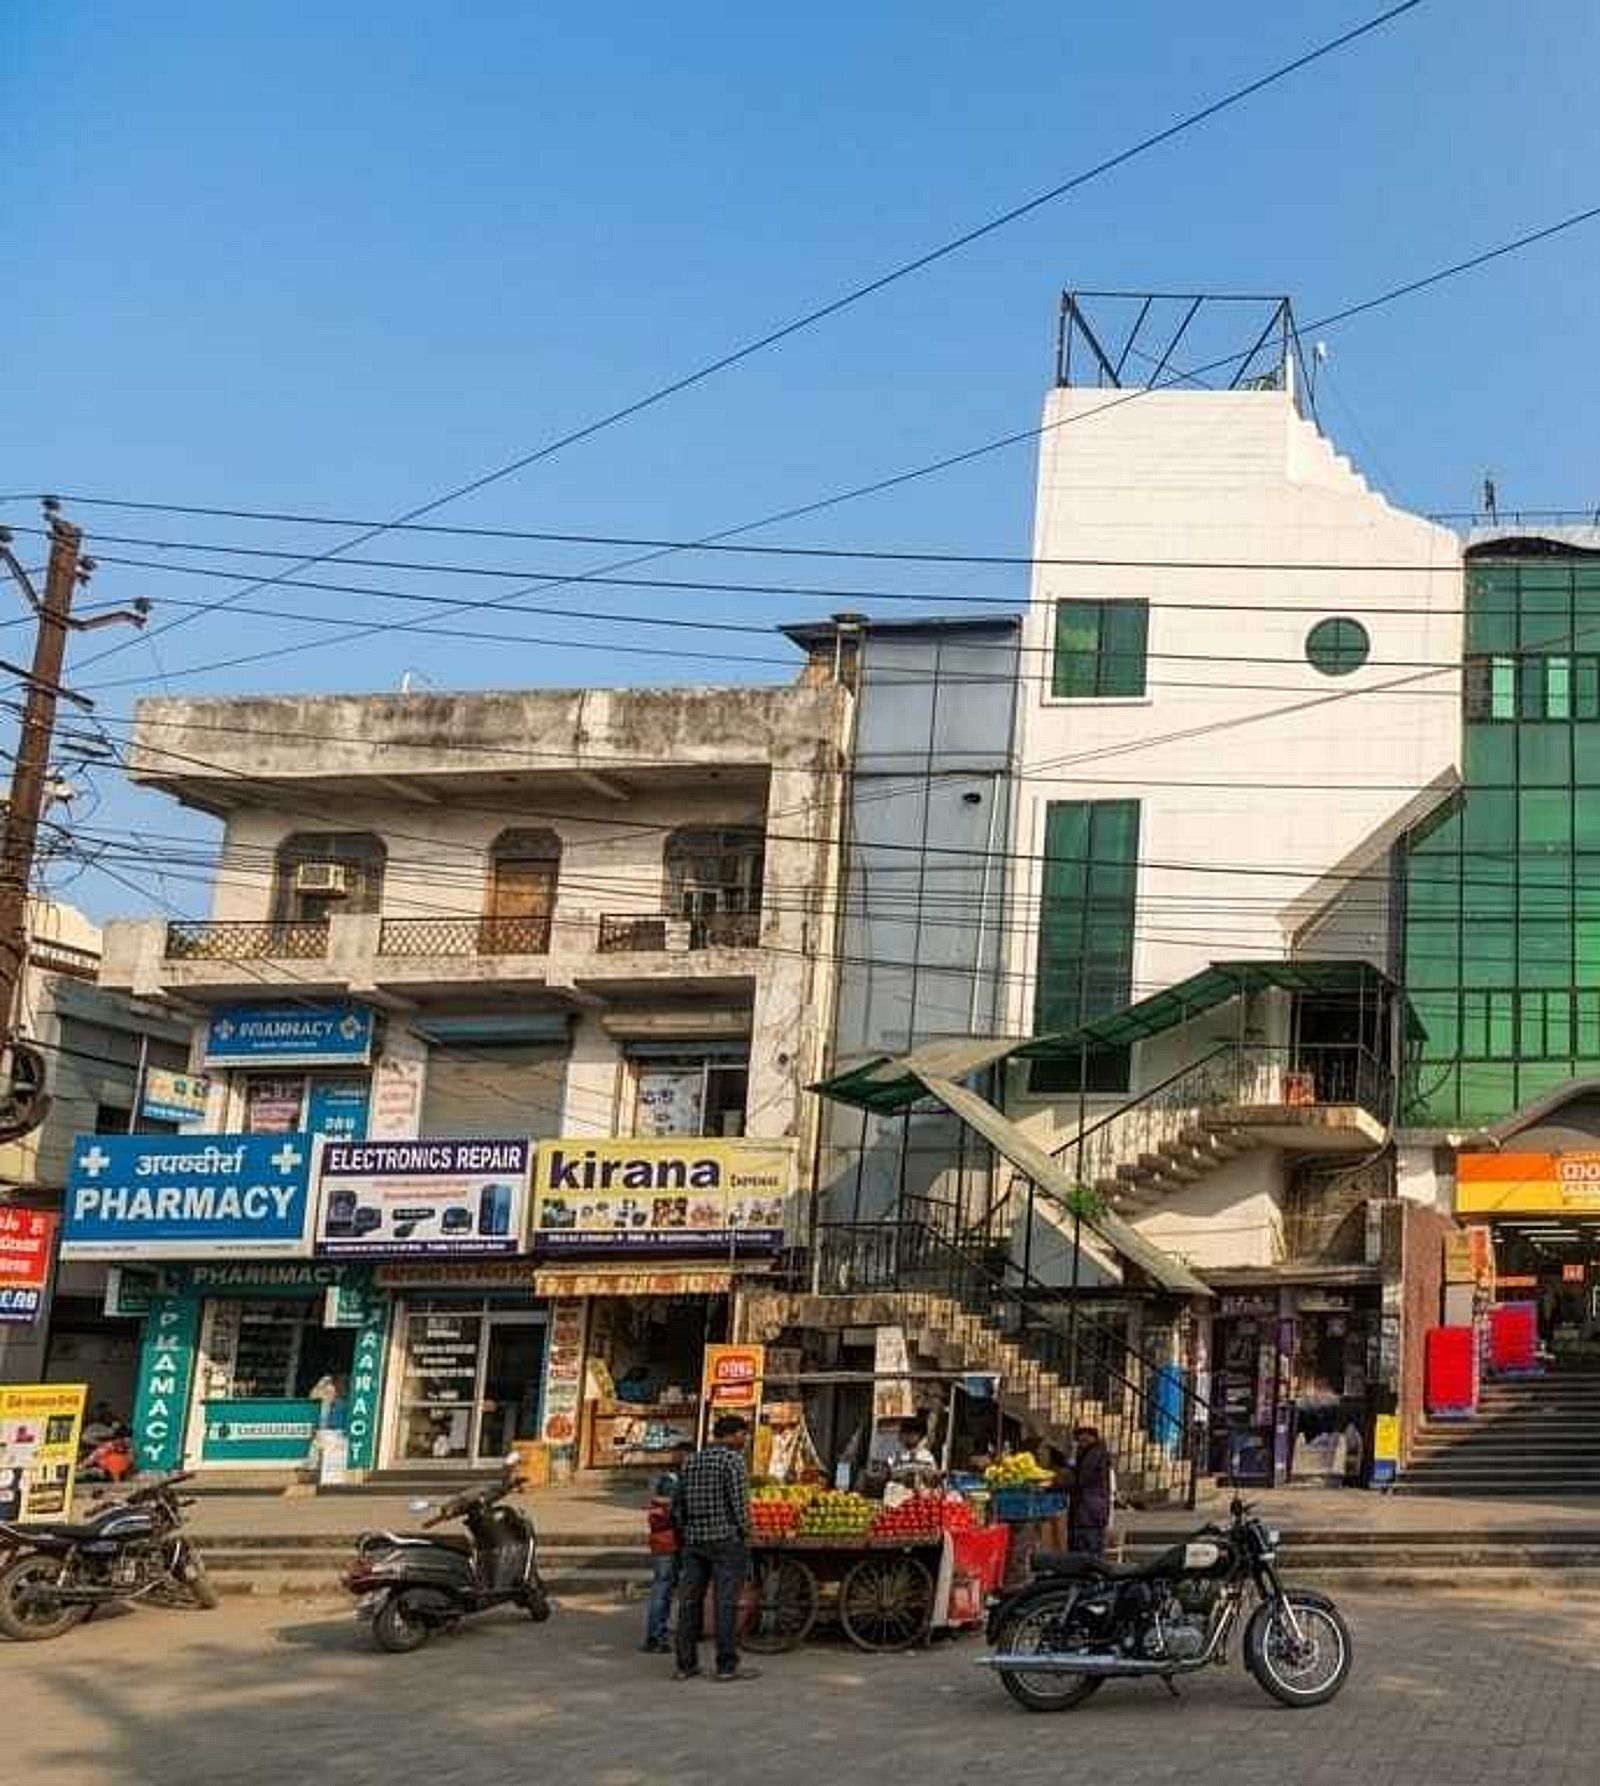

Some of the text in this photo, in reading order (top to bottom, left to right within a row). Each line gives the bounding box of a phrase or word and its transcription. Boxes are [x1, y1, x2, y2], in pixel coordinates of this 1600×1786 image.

[329, 1145, 521, 1171] ELECTRONICS REPAIR
[550, 1150, 721, 1190] kirana
[73, 1185, 298, 1220] PHARMACY
